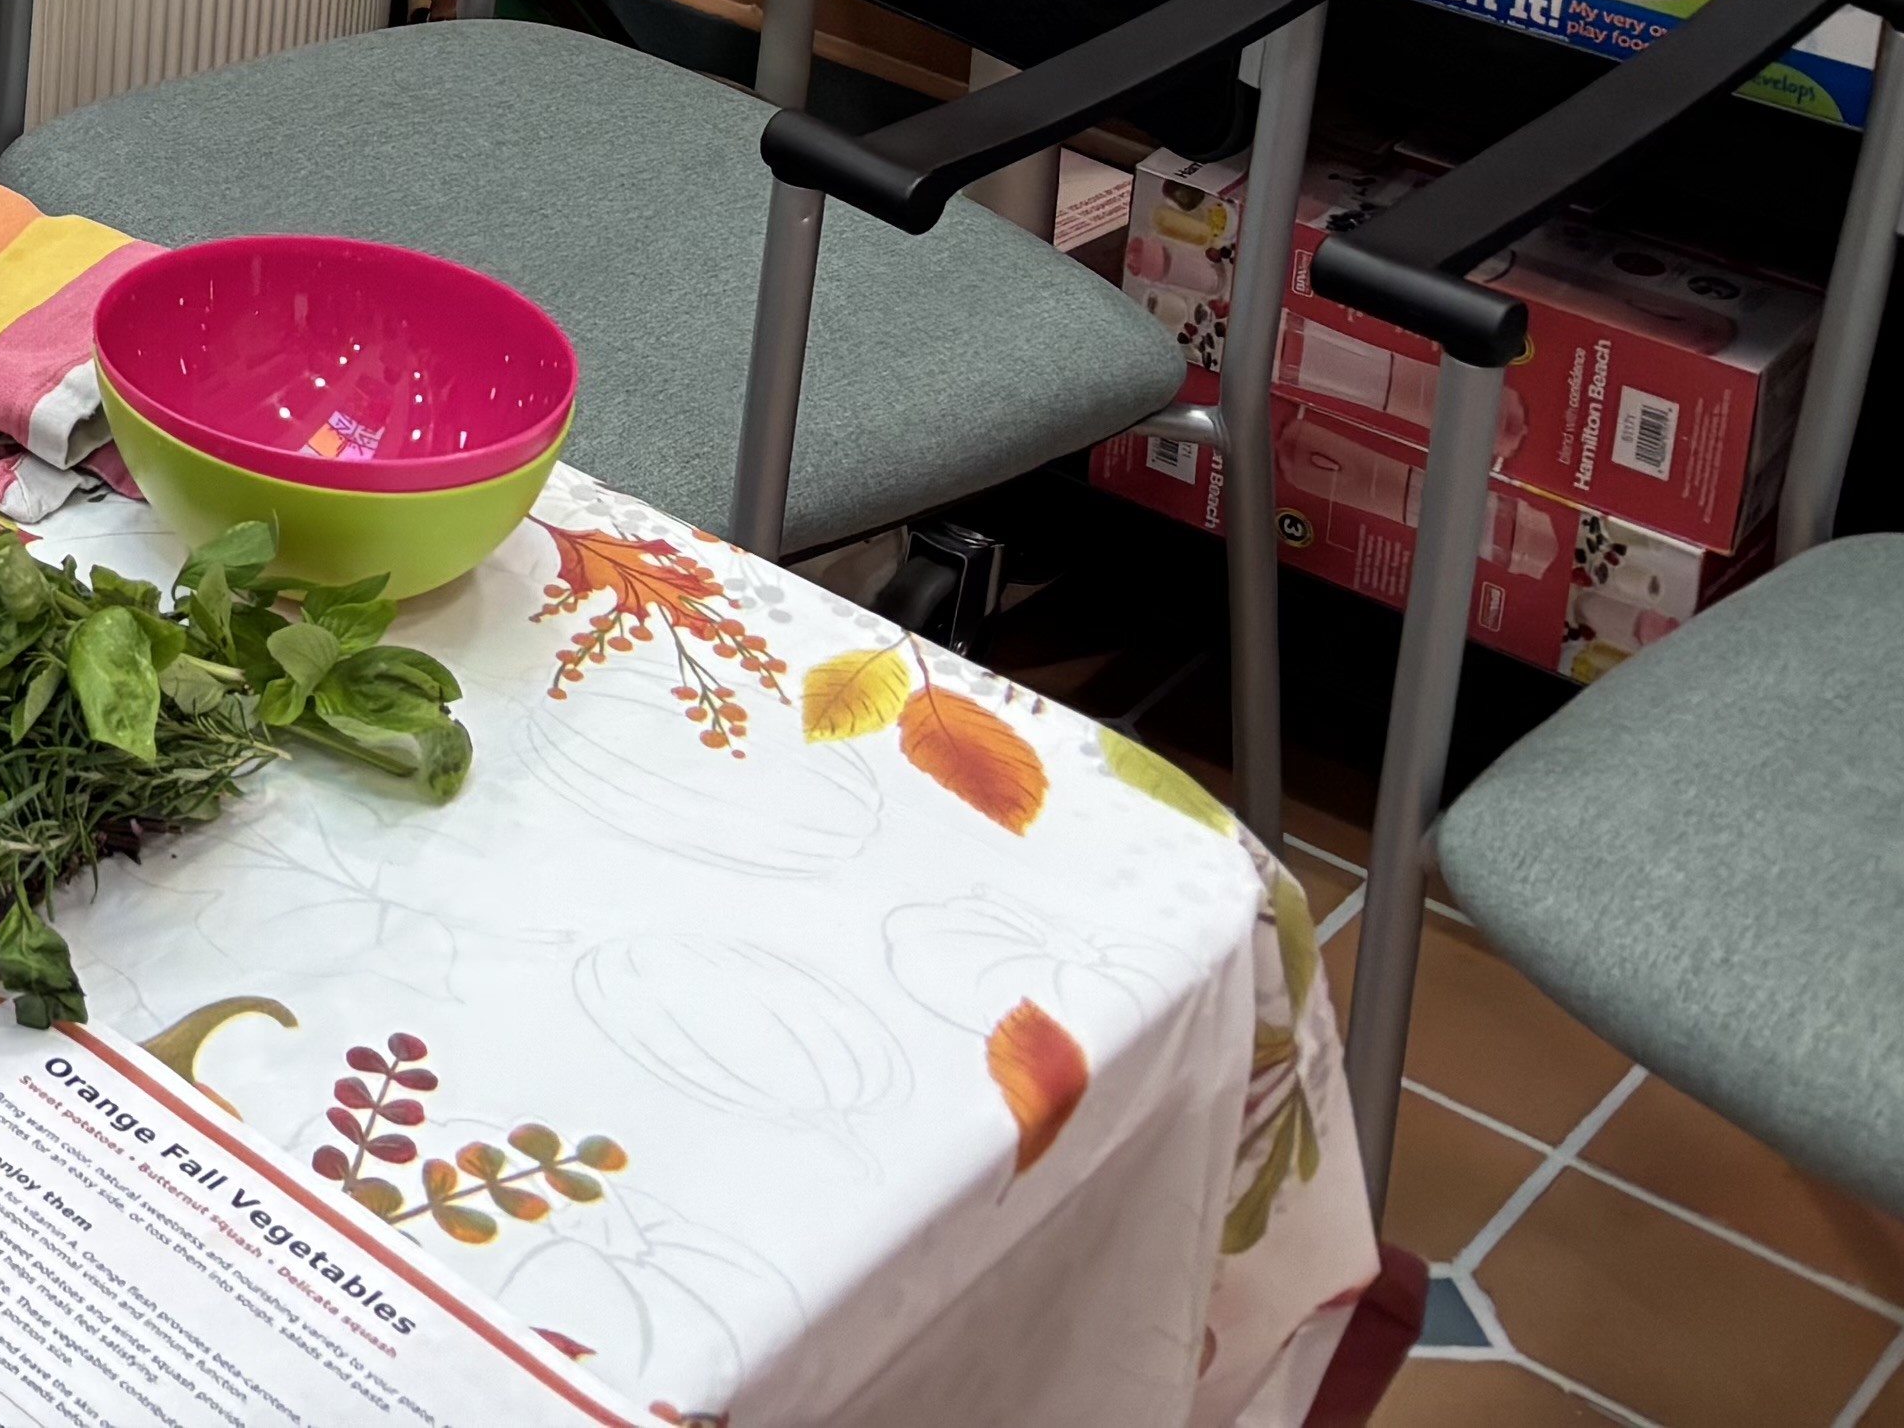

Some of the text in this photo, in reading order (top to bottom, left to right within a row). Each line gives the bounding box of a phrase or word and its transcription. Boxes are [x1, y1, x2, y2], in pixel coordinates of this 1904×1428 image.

[1566, 20, 1608, 44] play
[1603, 9, 1647, 34] very
[1567, 347, 1587, 408] confidence
[1573, 339, 1612, 491] Hamilton Beach
[1204, 472, 1225, 529] Beach
[1282, 518, 1305, 537] 3
[19, 1075, 62, 1110] Sweet
[61, 1109, 124, 1155] potatoes
[137, 1162, 209, 1215] Butternut
[209, 1214, 262, 1258] squash
[341, 1316, 396, 1358] squash
[26, 1117, 59, 1143] warm
[95, 1167, 141, 1201] natural
[139, 1201, 205, 1250] sweetness
[205, 1251, 233, 1271] and
[232, 1270, 299, 1324] nourishing
[301, 1322, 348, 1358] variety
[349, 1357, 364, 1371] to
[364, 1371, 398, 1395] your
[42, 1191, 92, 1231] them
[45, 1058, 415, 1334] Orange Fall Vegetables
[3, 1255, 36, 1285] helps
[36, 1284, 73, 1316] meals
[74, 1314, 100, 1335] feel
[4, 1191, 22, 1205] for
[22, 1205, 66, 1240] vitamin
[82, 1251, 126, 1287] Orange
[127, 1286, 157, 1312] flesh
[156, 1311, 211, 1354] provides
[31, 1139, 50, 1153] for
[49, 1154, 67, 1166] an
[67, 1166, 97, 1188] easy
[128, 1213, 144, 1223] or
[144, 1223, 171, 1245] toss
[172, 1243, 206, 1272] them
[207, 1271, 234, 1293] into
[278, 1326, 322, 1360] salads
[323, 1360, 352, 1381] and
[38, 1236, 83, 1271] normal
[82, 1270, 117, 1300] vision
[117, 1300, 145, 1320] and
[143, 1318, 194, 1361] immune
[31, 1260, 85, 1304] potatoes
[85, 1304, 112, 1324] and
[111, 1324, 151, 1354] winter
[150, 1355, 195, 1391] squash
